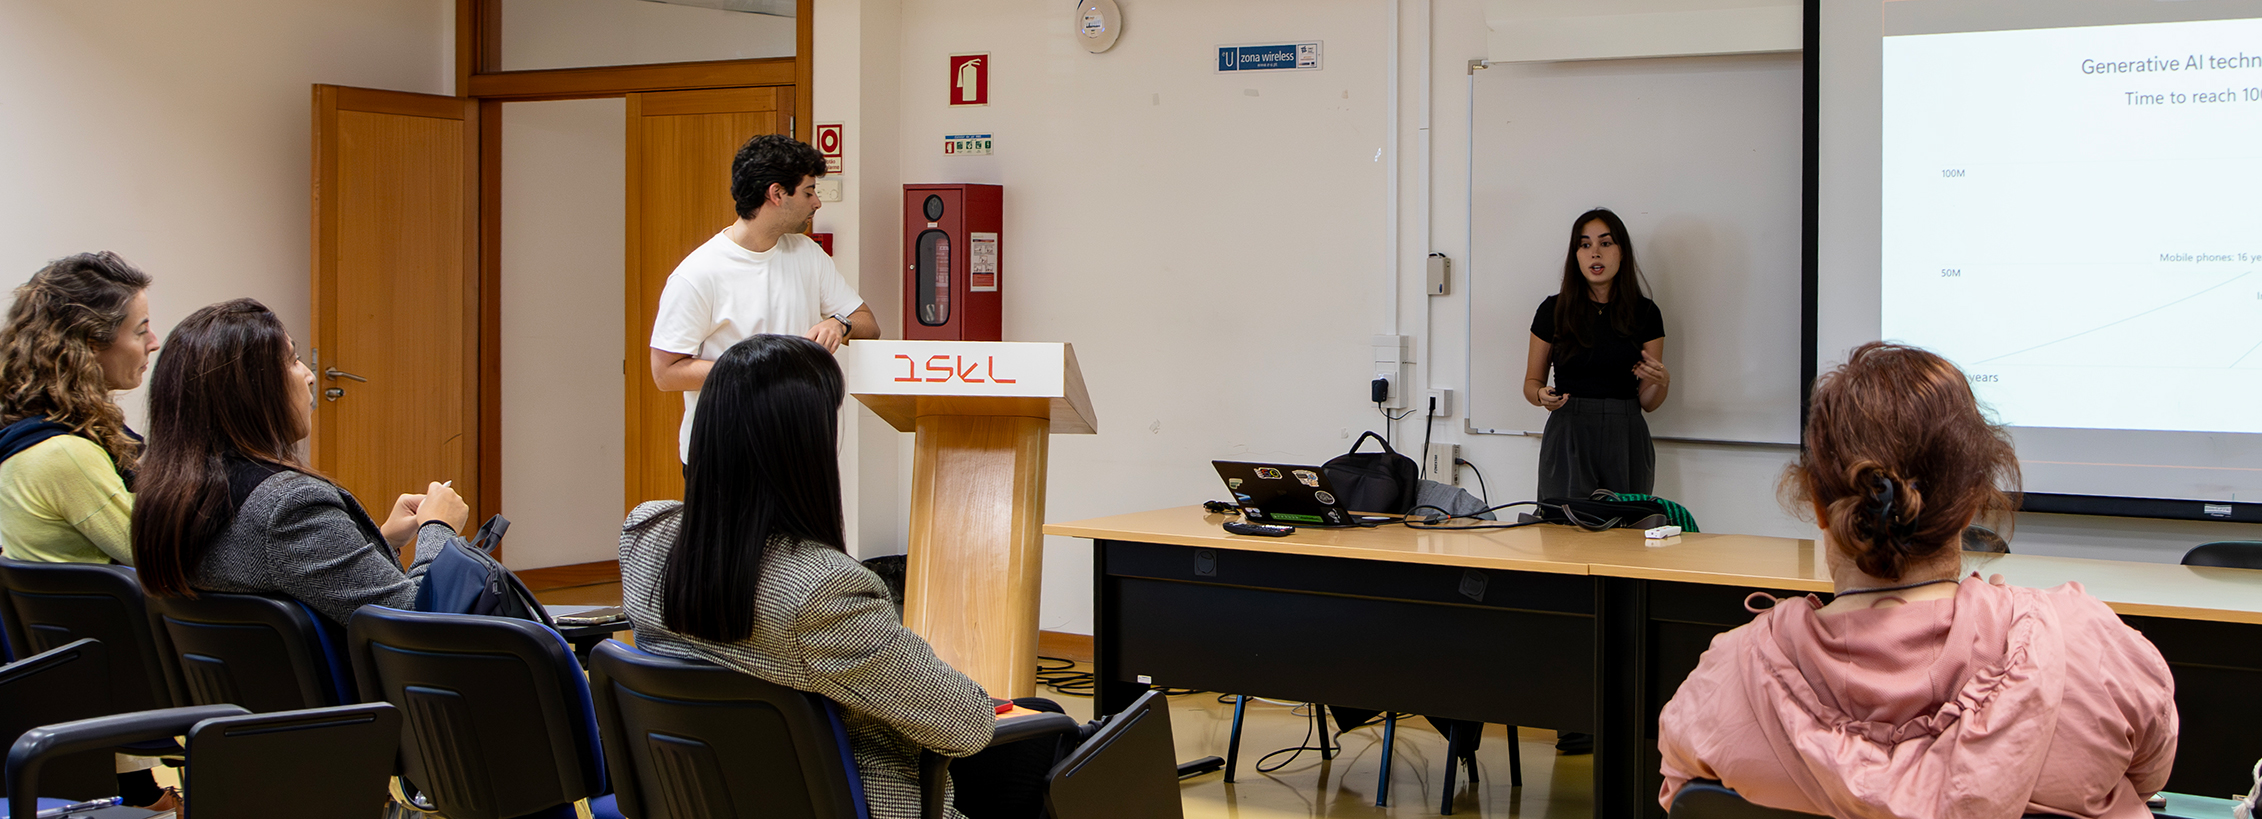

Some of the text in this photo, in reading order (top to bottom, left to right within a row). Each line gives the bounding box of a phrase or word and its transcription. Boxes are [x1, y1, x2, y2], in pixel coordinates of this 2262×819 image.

[1240, 54, 1260, 63] zona
[1261, 50, 1295, 62] wireless
[2081, 51, 2262, 75] Generative AI techn
[2125, 87, 2262, 106] Time to reach 10
[1941, 168, 1966, 178] 100M
[2159, 252, 2194, 262] Mobile
[2195, 252, 2235, 264] phones:
[2237, 252, 2248, 262] 16
[1941, 268, 1961, 278] 50M
[1968, 373, 1999, 385] years
